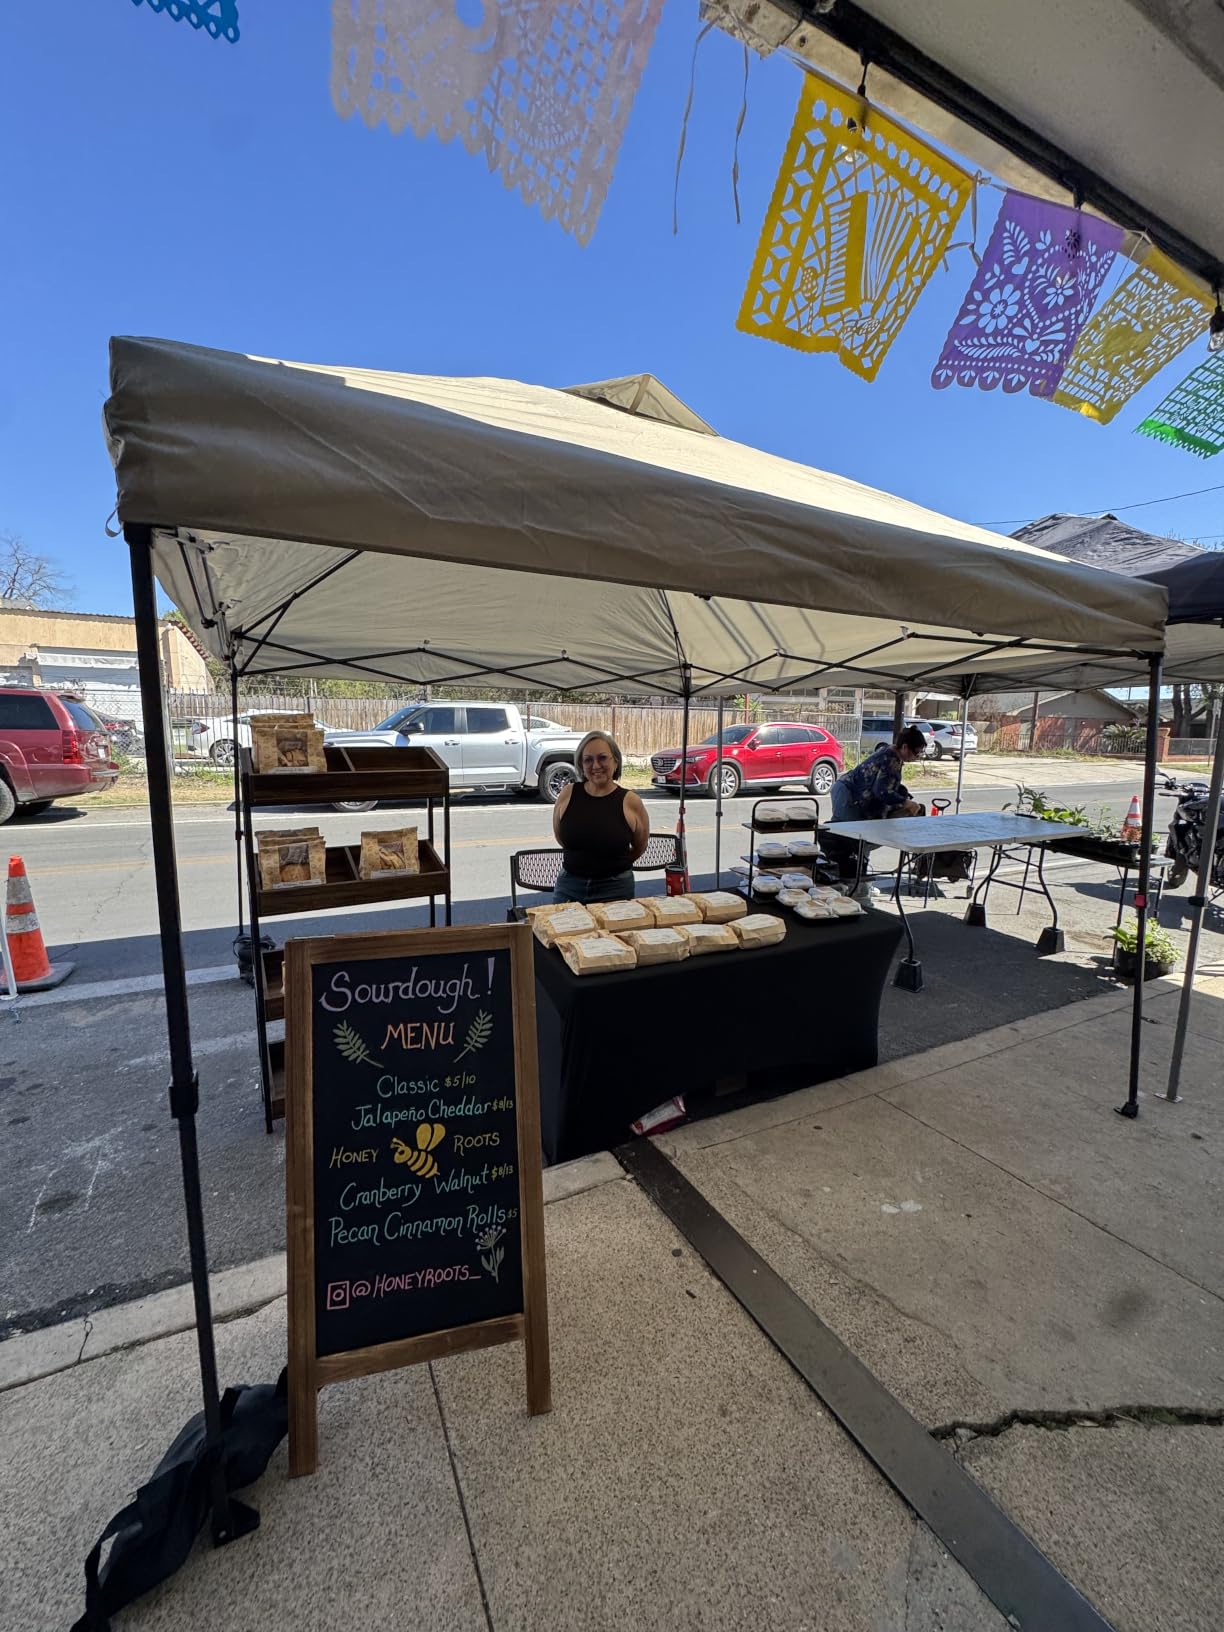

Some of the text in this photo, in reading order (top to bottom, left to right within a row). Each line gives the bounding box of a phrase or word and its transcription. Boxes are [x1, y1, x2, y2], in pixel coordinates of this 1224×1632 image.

[381, 1022, 455, 1050] MENU
[377, 1072, 476, 1098] Classic $5/10
[351, 1103, 426, 1130] Jalapeño
[428, 1095, 492, 1119] Cheddar
[329, 1133, 500, 1169] HONEY ROOTS
[339, 1163, 514, 1210] Cranberry Walnut $8/13
[328, 1216, 381, 1248] Pecan
[384, 1212, 463, 1239] Cinnamon
[466, 1204, 506, 1234] Rolls
